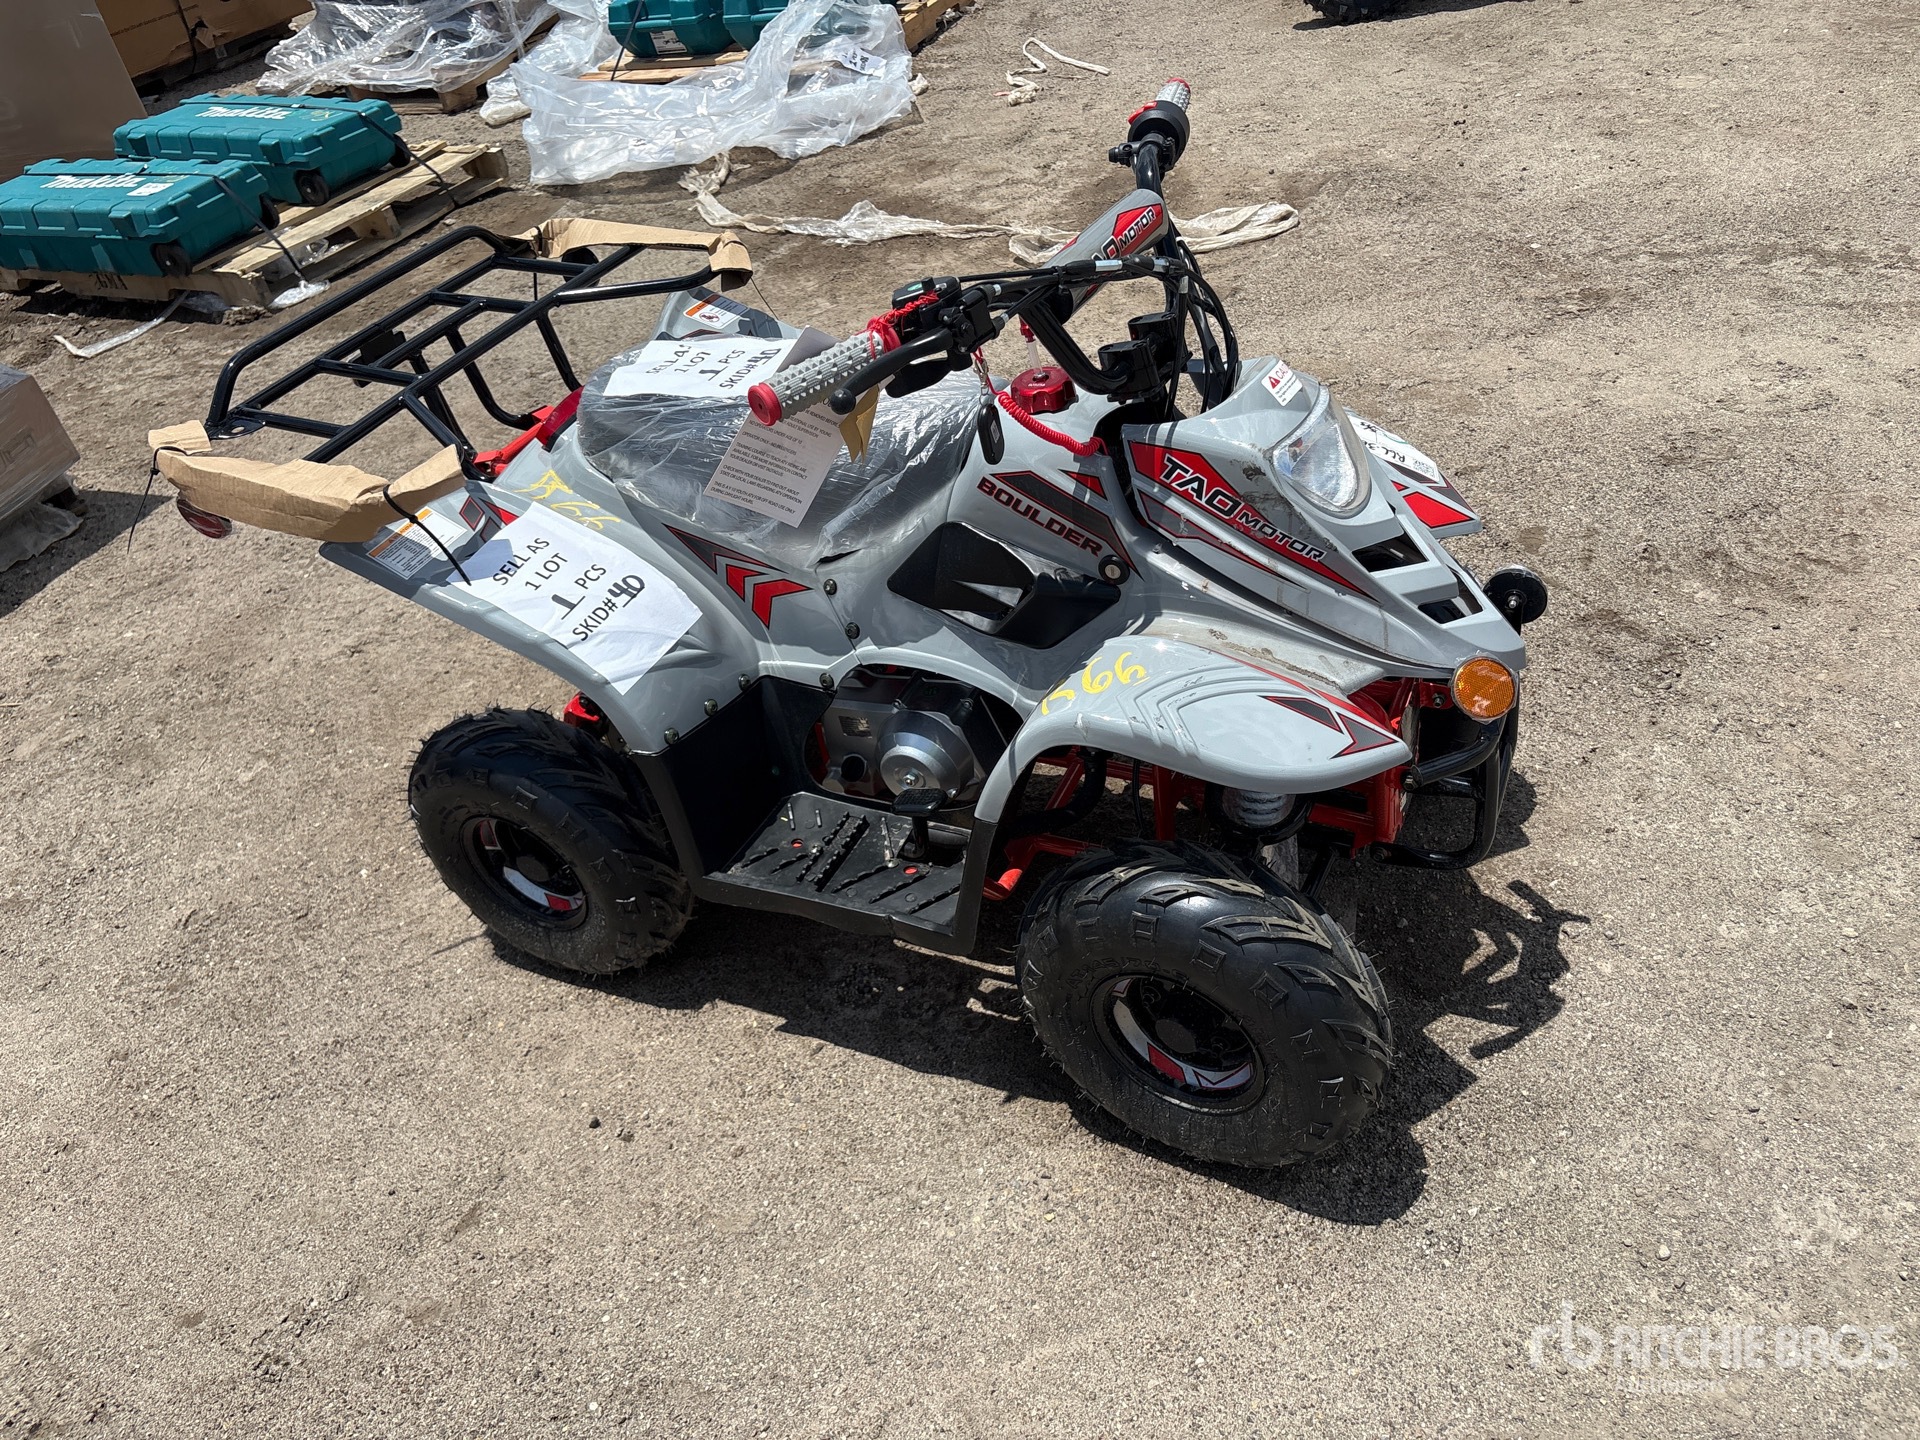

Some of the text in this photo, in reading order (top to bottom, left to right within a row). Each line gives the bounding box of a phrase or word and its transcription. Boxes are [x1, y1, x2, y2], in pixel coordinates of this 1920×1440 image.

[1118, 207, 1155, 250] MOTOR
[645, 358, 679, 374] SELL
[717, 350, 746, 364] PCS
[976, 476, 1104, 558] BOULDER
[493, 538, 550, 586] SELL AS
[525, 552, 568, 591] 1 LOT
[574, 564, 606, 590] PCS
